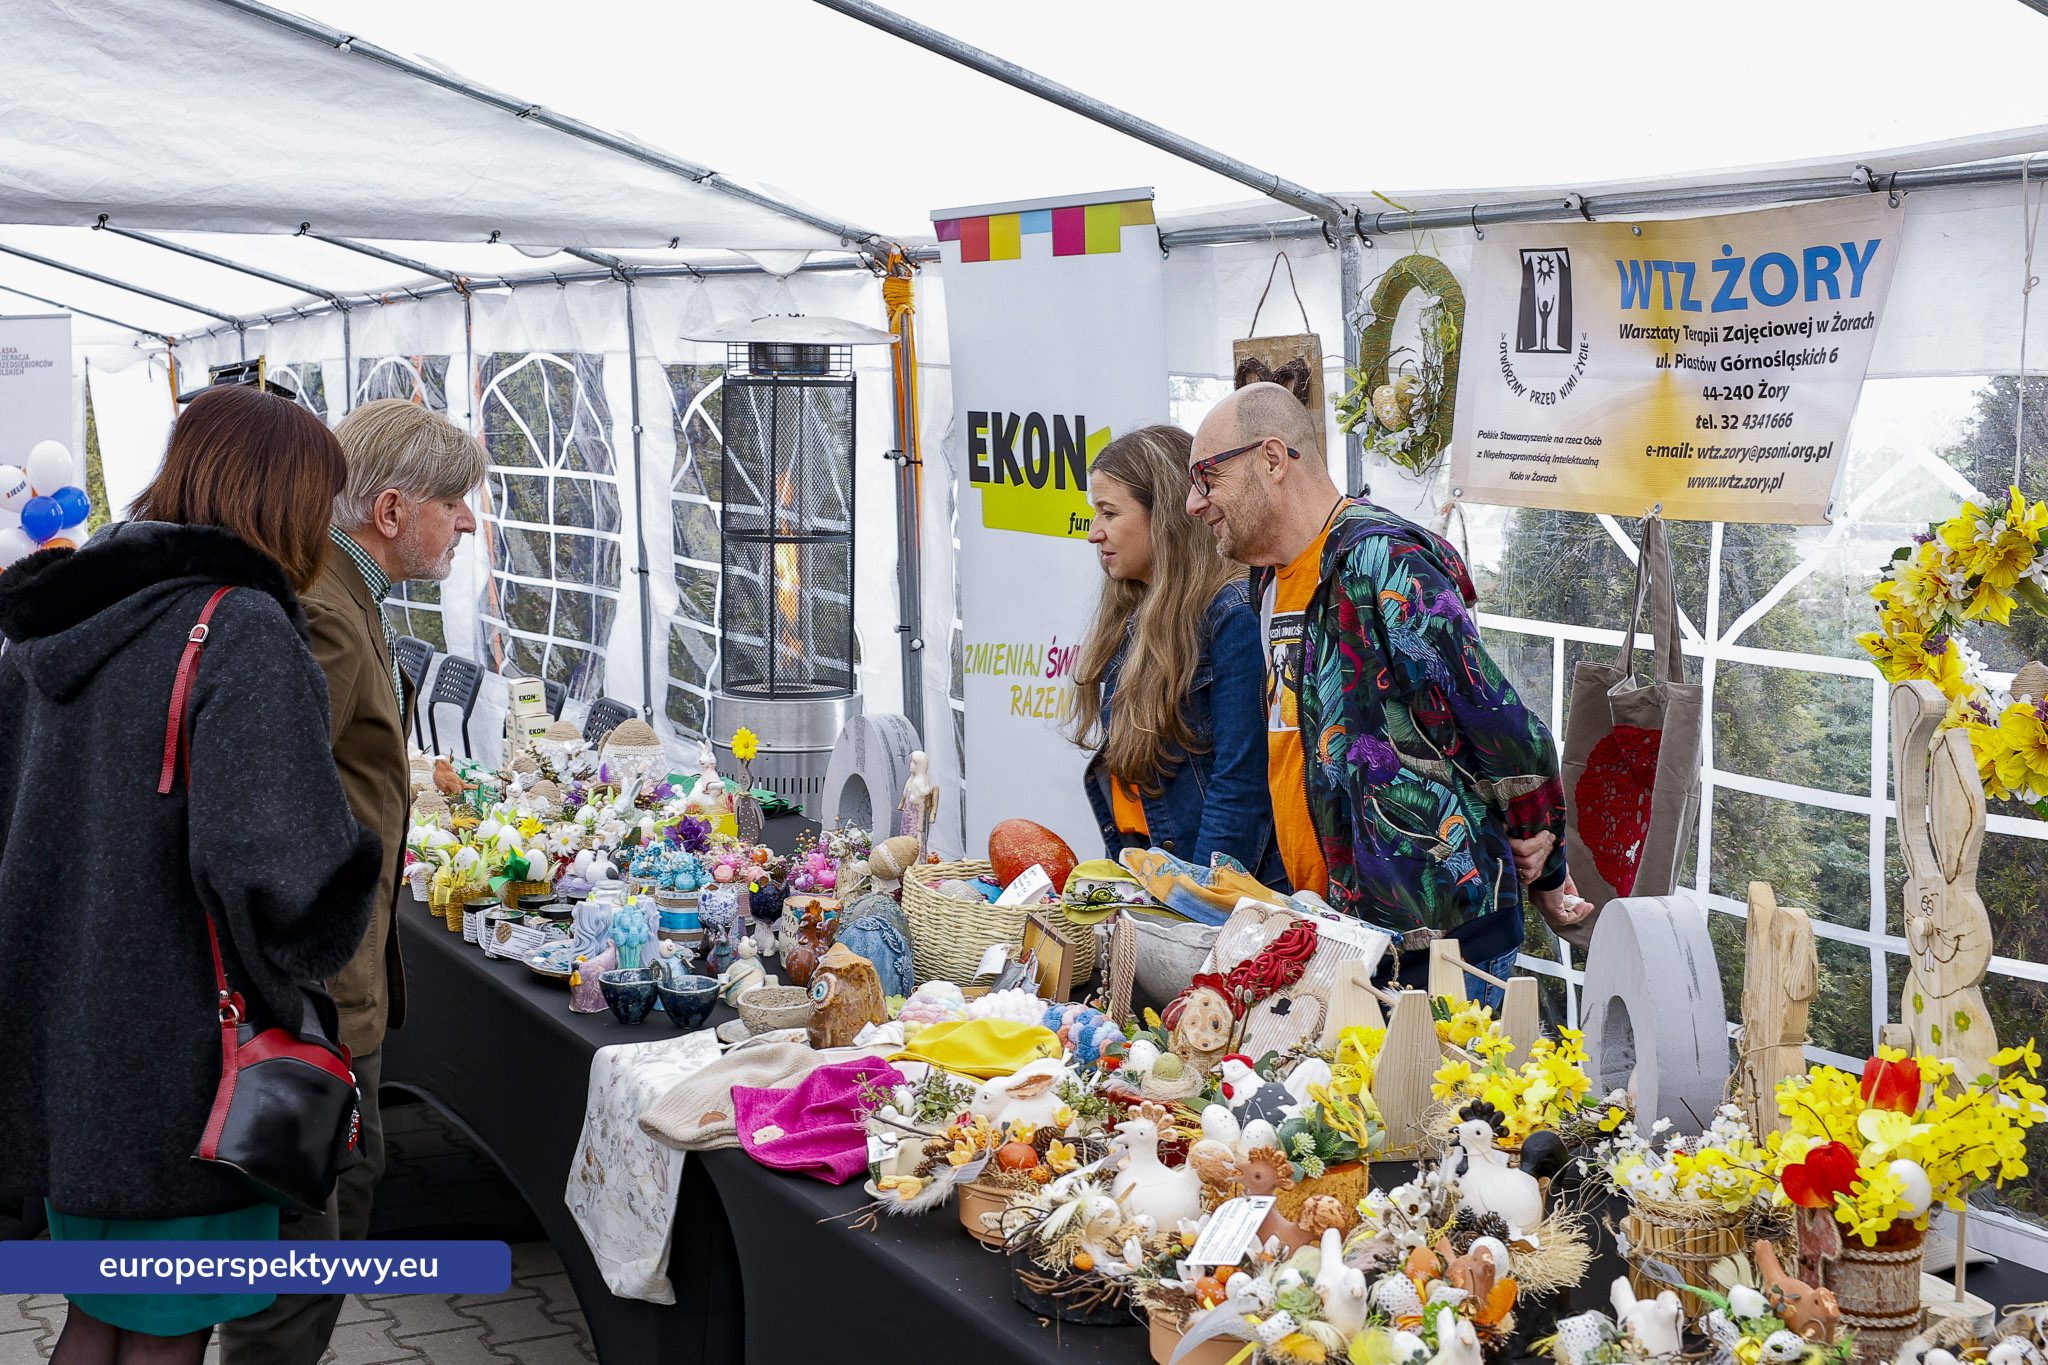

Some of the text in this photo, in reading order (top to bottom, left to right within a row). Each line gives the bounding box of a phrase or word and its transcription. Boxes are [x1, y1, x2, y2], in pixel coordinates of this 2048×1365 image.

[1615, 238, 1882, 313] WTZ ŻORY
[1619, 311, 1875, 346] Warsztaty Terapii Zajęciowej w Żorach
[1656, 347, 1838, 372] ul. Piastów Górnośląskich 6
[1500, 341, 1589, 405] OTWÓRZMY PRZED NIMI ŻYCIE
[1703, 379, 1790, 402] 44-240 Żory
[1695, 412, 1794, 430] tel. 32 4341666
[1477, 430, 1499, 440] Polskie
[1500, 431, 1552, 443] Stowarzyszenie
[1584, 436, 1602, 446] Osób
[967, 411, 1088, 492] EKON
[1552, 454, 1599, 468] Intelektualną
[1645, 441, 1834, 463] e-mail: wtz.zory@psoni.org.pl
[1531, 471, 1557, 483] Żorach
[1687, 472, 1785, 493] www.wtz.zory.pl
[1067, 511, 1094, 535] fun
[963, 643, 1044, 677] ZMIENIAJ
[518, 694, 536, 702] EKON
[528, 727, 546, 736] EKON
